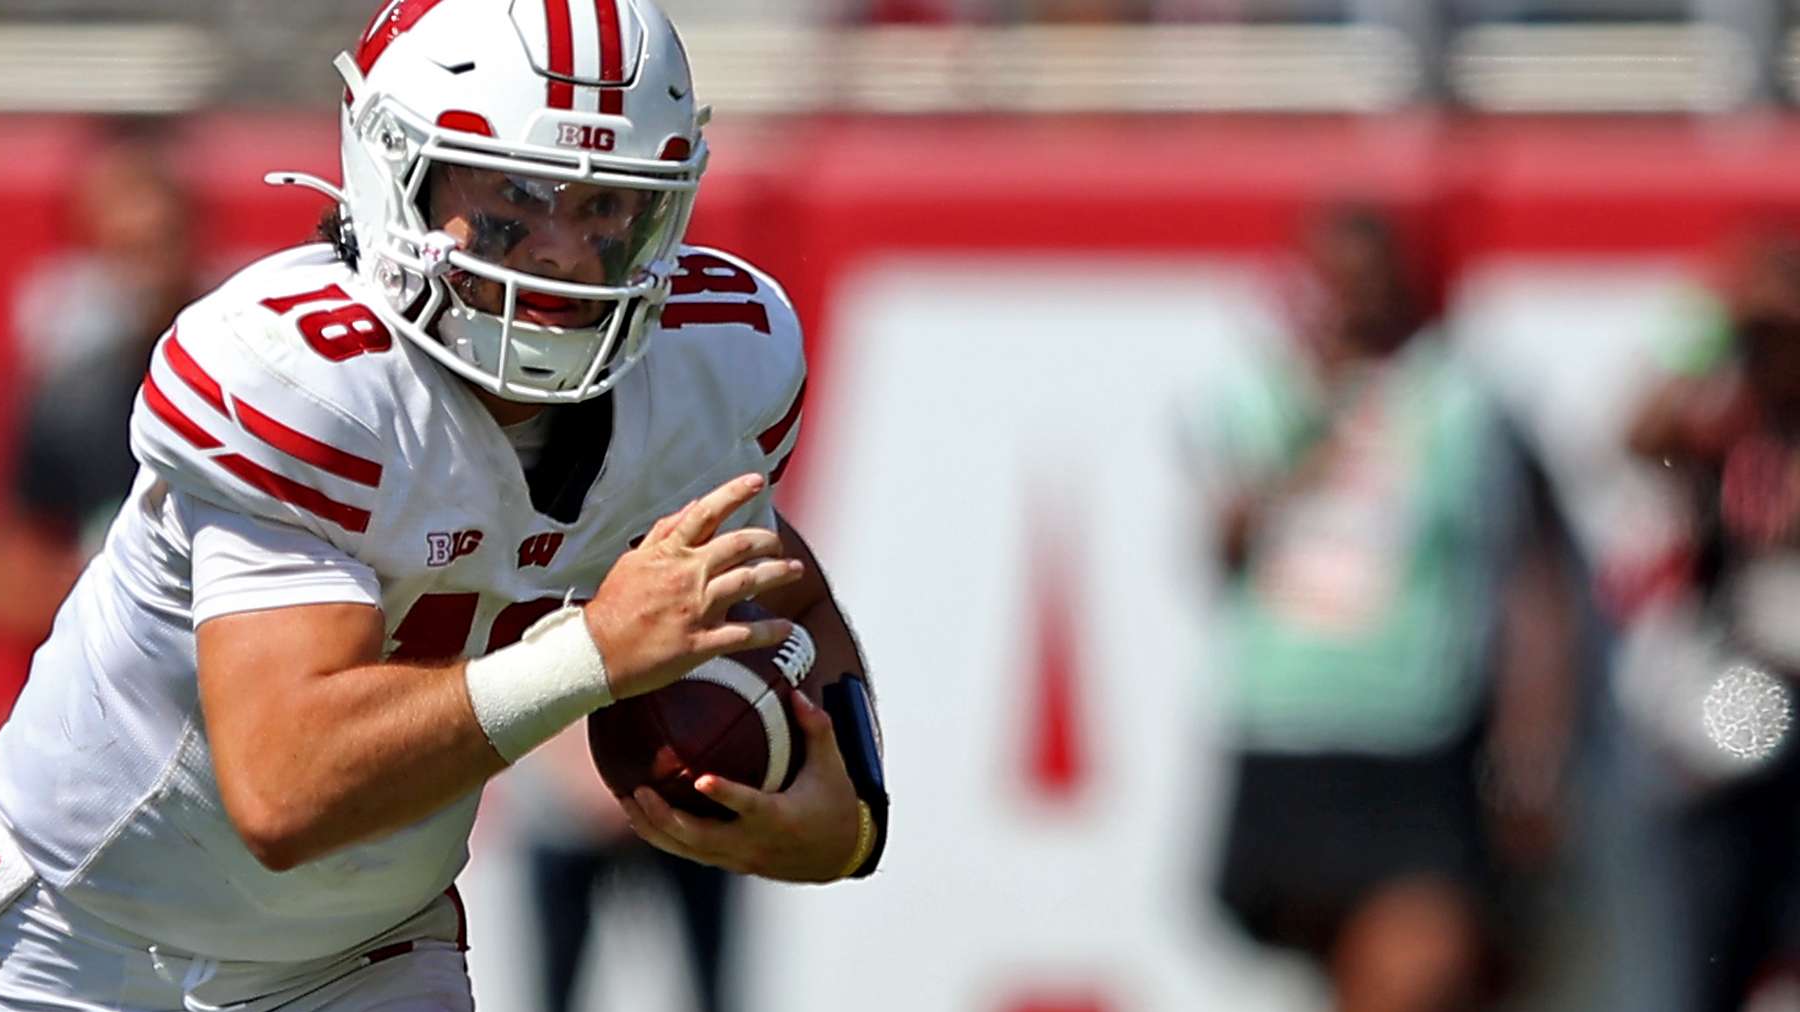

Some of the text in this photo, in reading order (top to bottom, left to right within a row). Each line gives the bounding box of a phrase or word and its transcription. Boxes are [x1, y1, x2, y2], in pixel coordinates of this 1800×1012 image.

[260, 283, 393, 363] 18
[658, 253, 771, 335] 18
[517, 532, 564, 568] W
